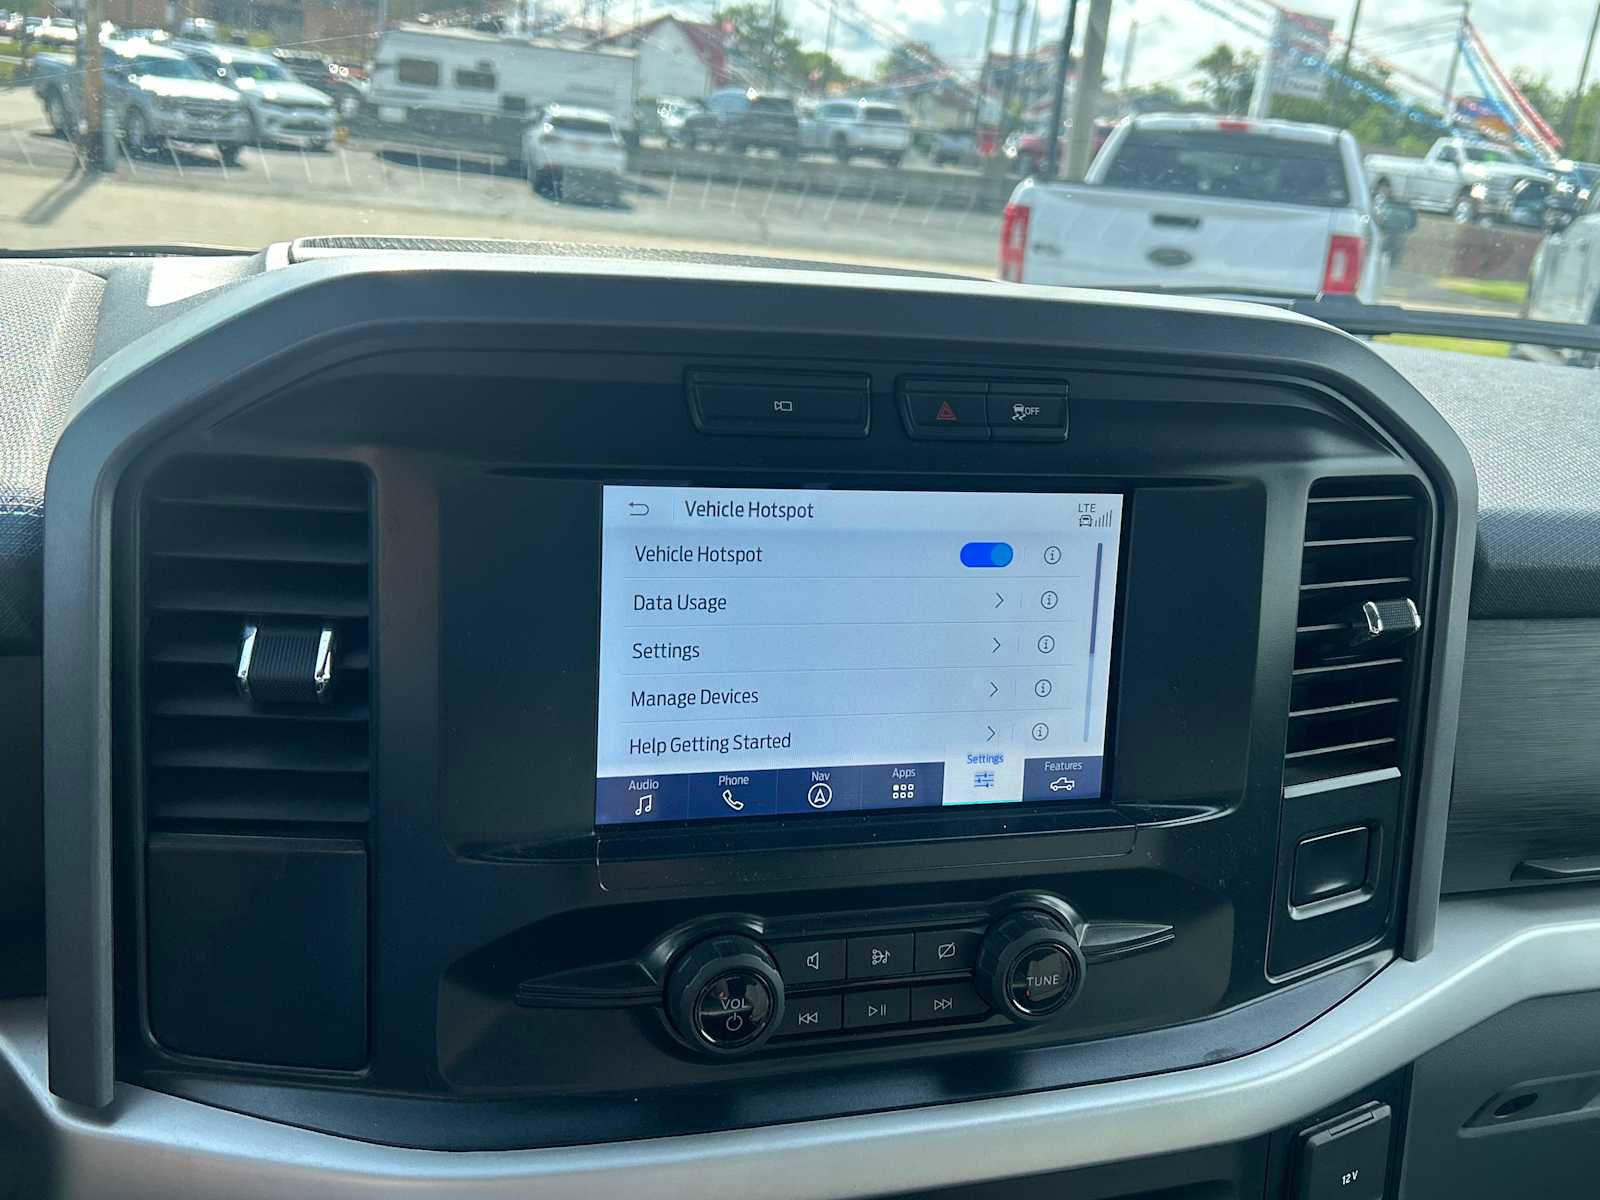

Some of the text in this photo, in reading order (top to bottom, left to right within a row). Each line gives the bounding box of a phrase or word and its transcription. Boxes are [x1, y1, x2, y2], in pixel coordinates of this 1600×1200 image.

[1024, 406, 1040, 416] OFF
[684, 499, 814, 520] Vehicle Hotspot
[1077, 503, 1097, 512] LTE
[634, 545, 763, 565] Vehicle Hotspot
[633, 593, 727, 613] Data Usage
[631, 642, 700, 661] Settings
[631, 688, 759, 708] Manage Devices
[629, 731, 791, 756] Help Getting Started
[965, 753, 1006, 767] Settings
[1043, 760, 1083, 772] Features
[718, 774, 750, 785] Phone
[810, 770, 831, 783] Nav
[891, 767, 916, 779] Apps
[628, 778, 661, 792] Audio
[1026, 974, 1060, 987] TUNE
[721, 998, 750, 1010] VOL
